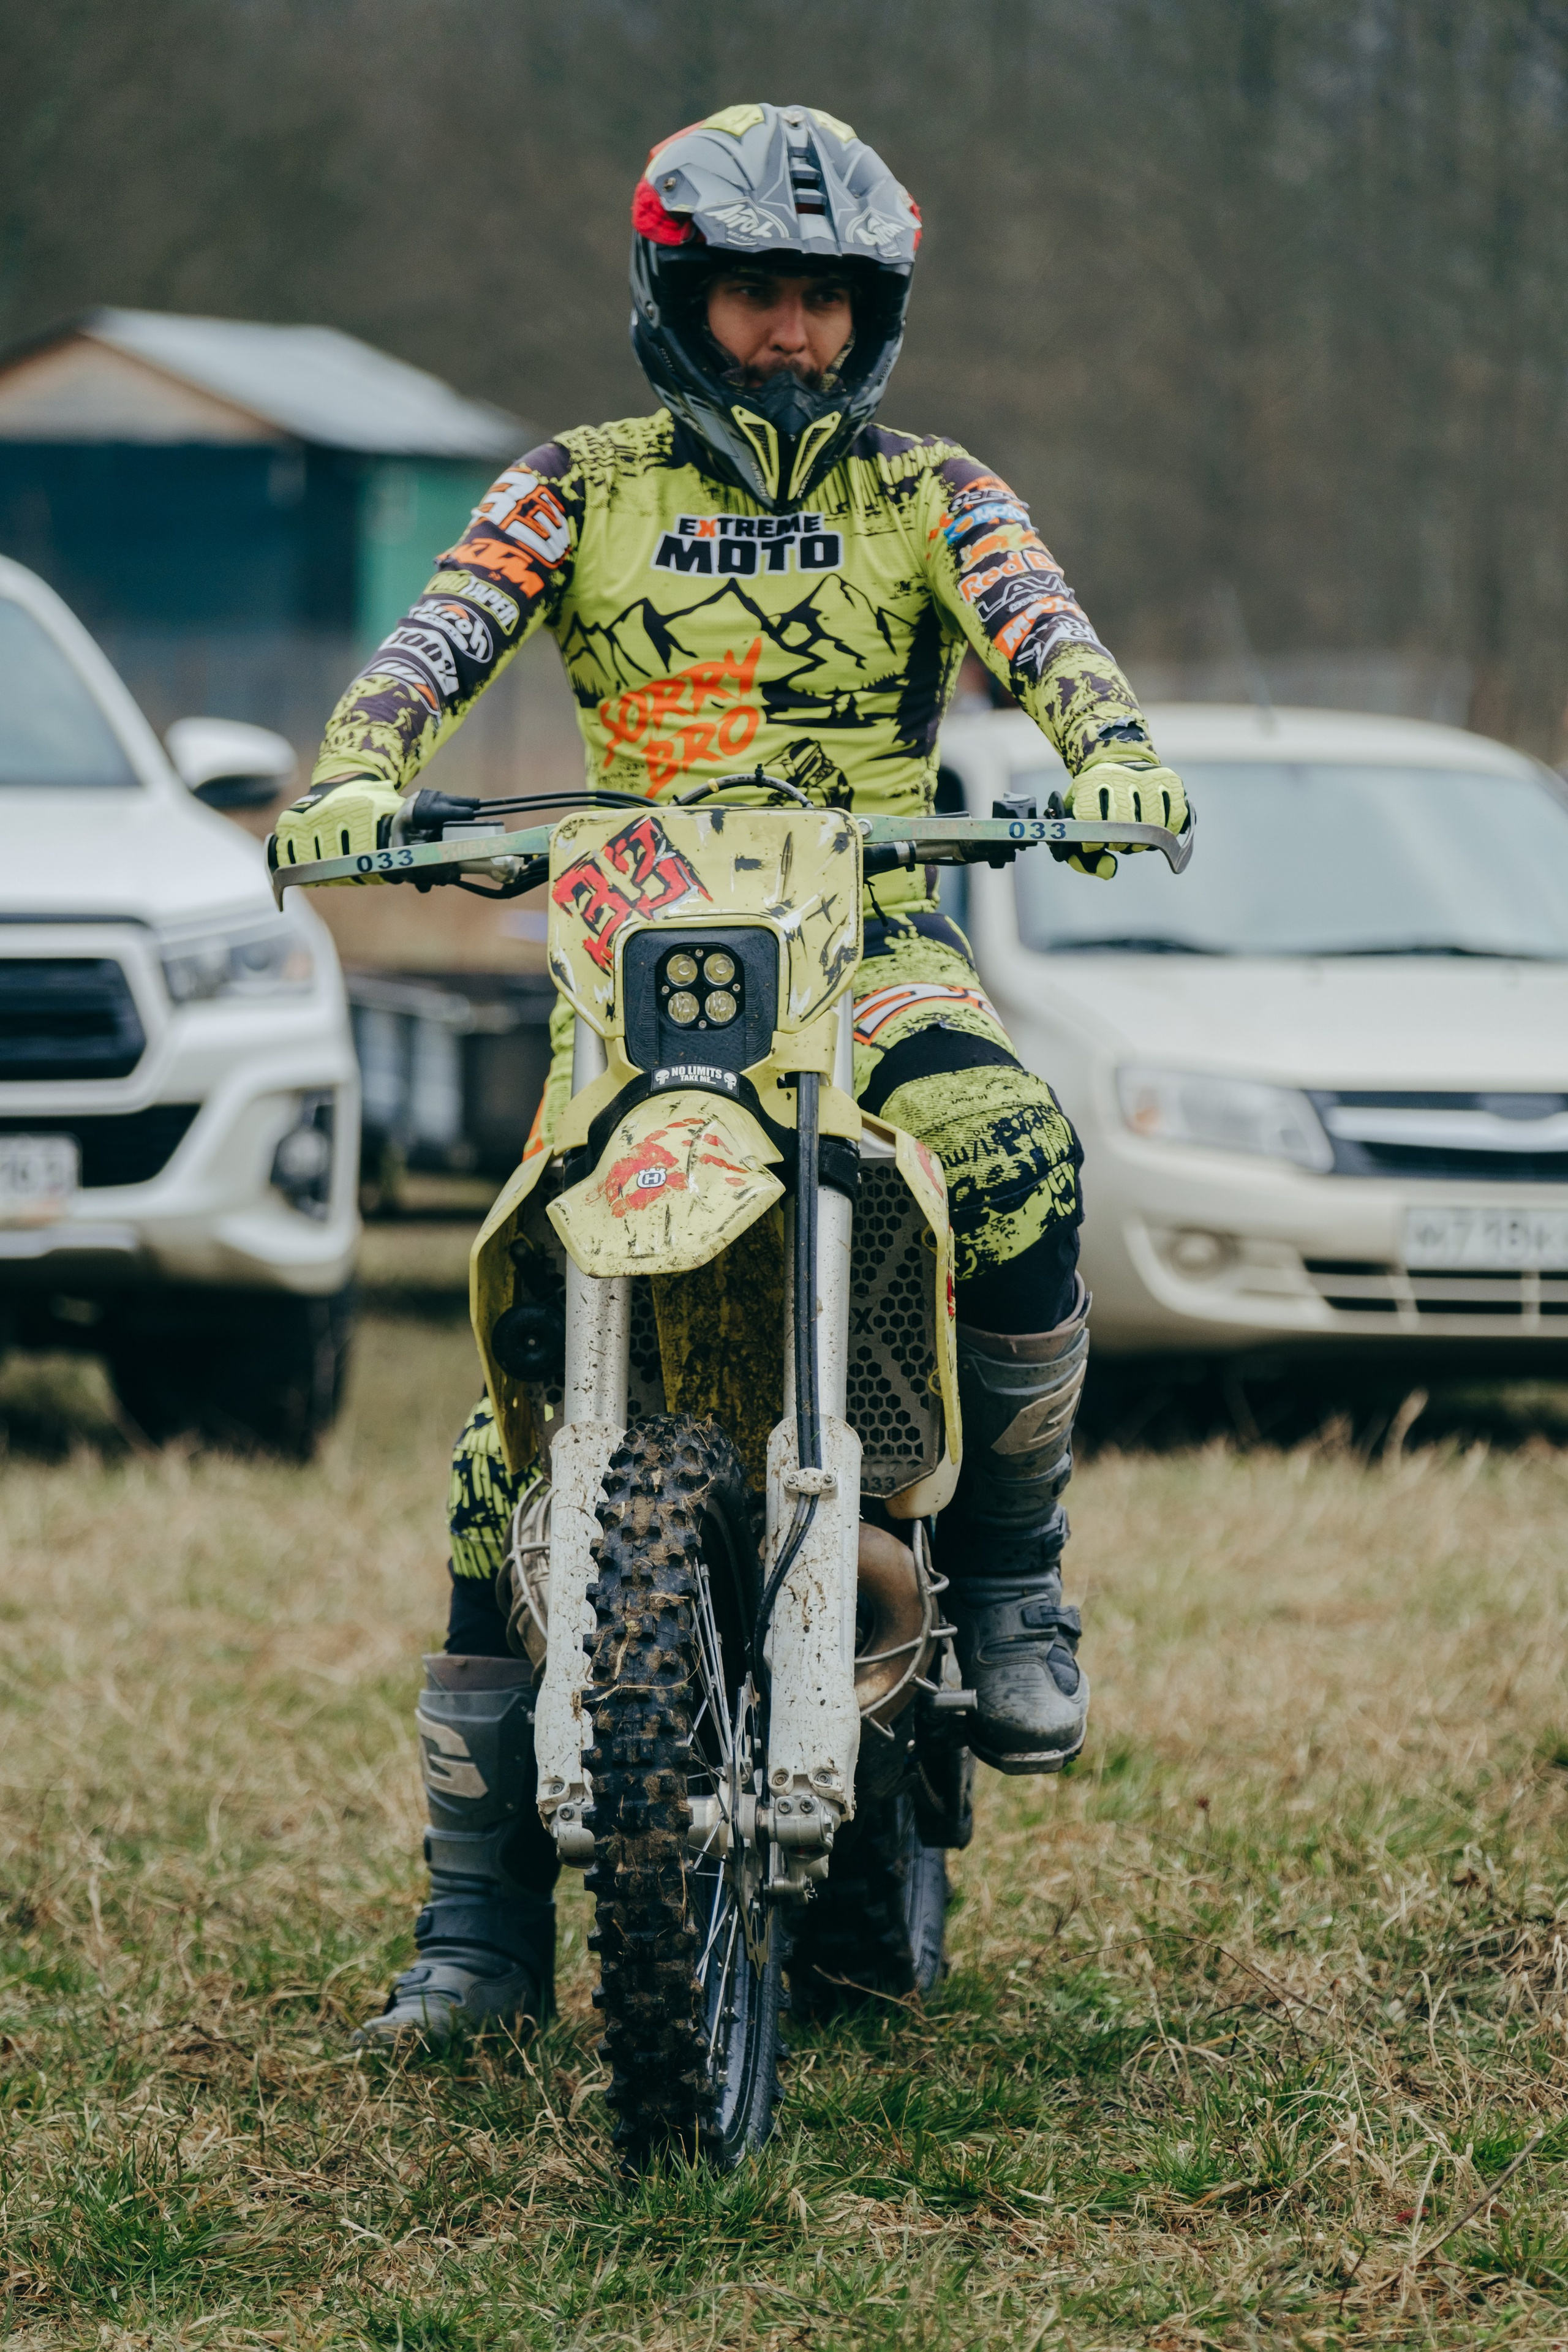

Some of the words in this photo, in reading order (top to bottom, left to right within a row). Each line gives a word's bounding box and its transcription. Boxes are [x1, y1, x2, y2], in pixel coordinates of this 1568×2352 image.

[678, 515, 821, 538] EXTREME
[655, 534, 840, 575] MOTO
[958, 551, 1031, 606] Red
[641, 705, 760, 800] BRO
[1009, 821, 1066, 840] 033
[356, 849, 413, 873] 033
[671, 1066, 686, 1077] NO
[687, 1066, 722, 1079] LIMITS
